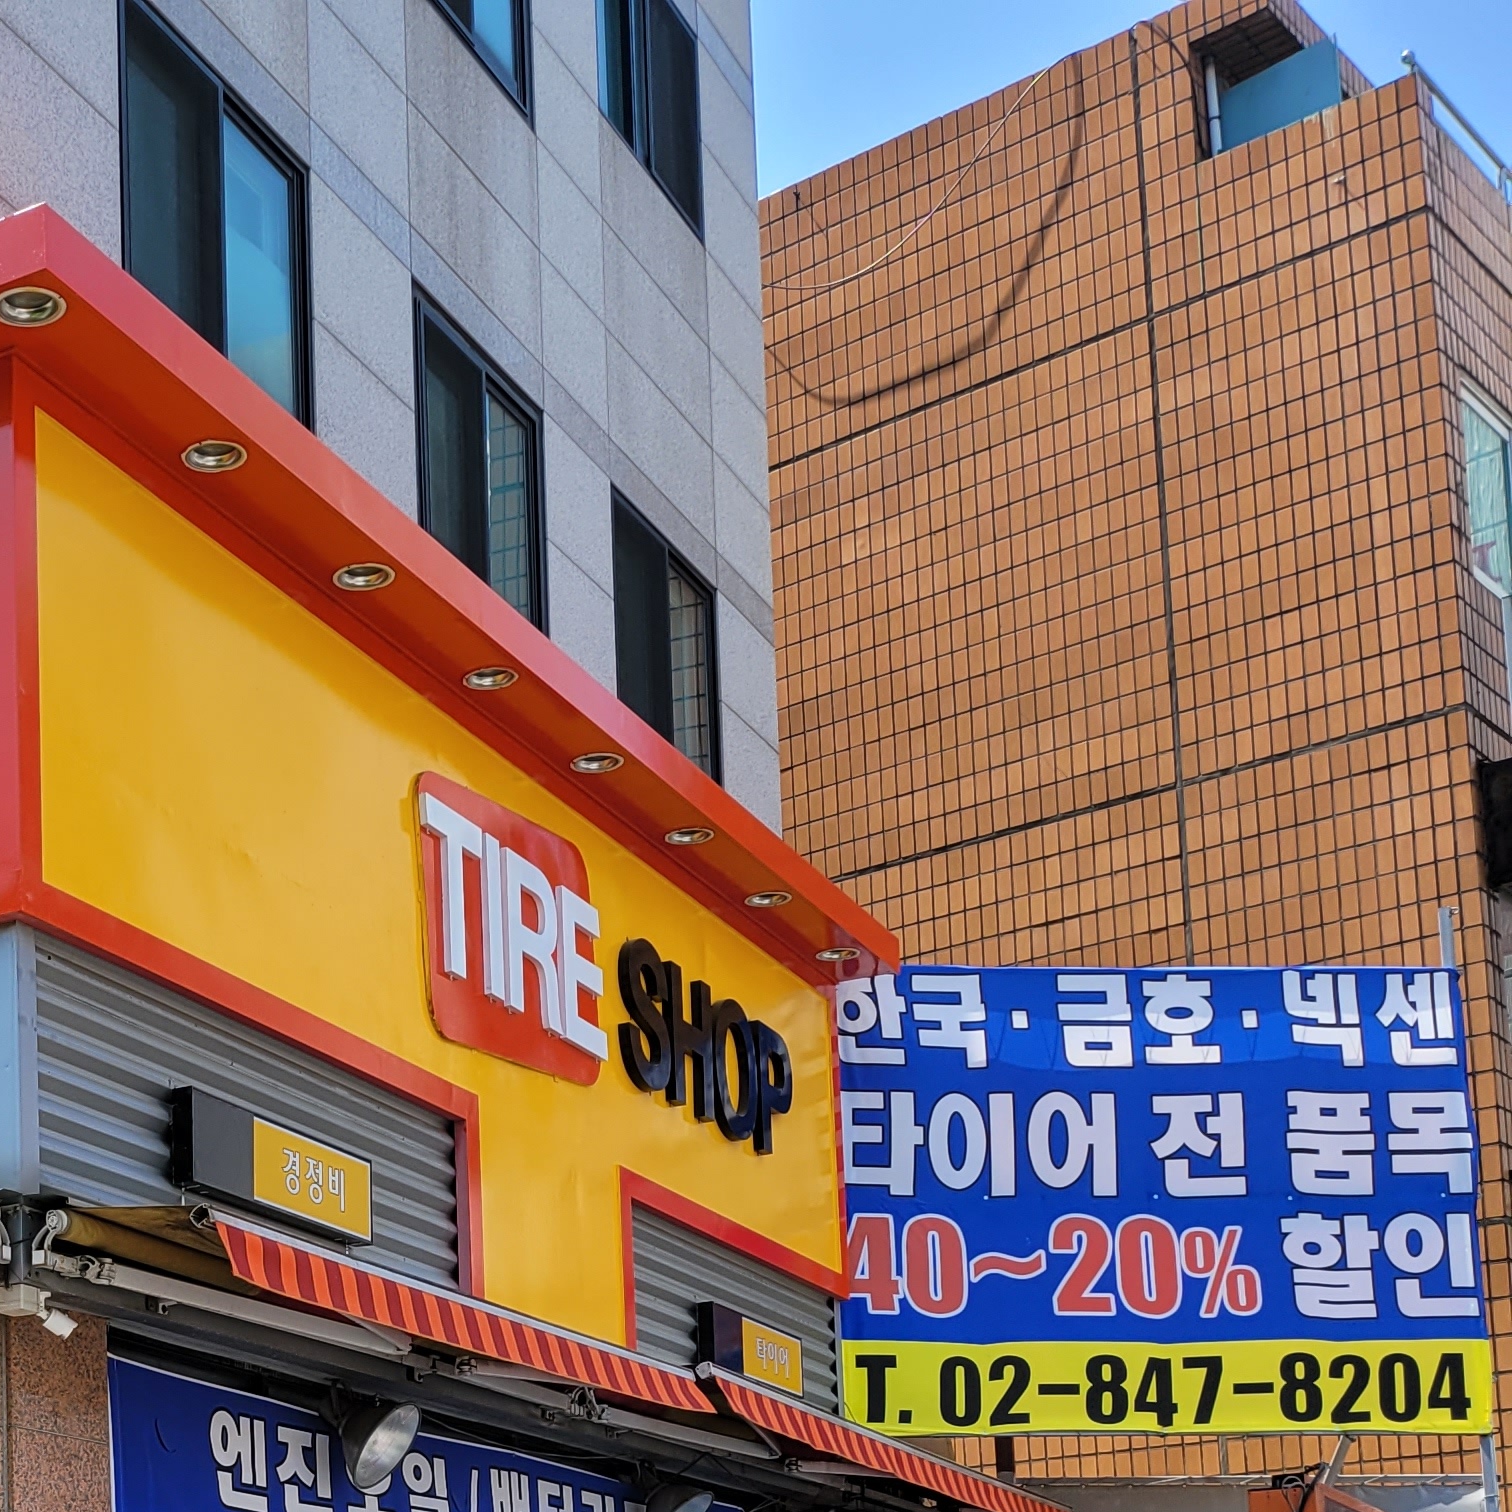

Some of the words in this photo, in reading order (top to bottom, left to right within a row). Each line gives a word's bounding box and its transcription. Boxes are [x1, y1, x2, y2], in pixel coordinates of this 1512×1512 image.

[419, 792, 608, 1062] TIRE
[617, 937, 793, 1156] SHOP
[281, 1147, 346, 1213] 경정비
[841, 1089, 1118, 1199] 타이어
[1150, 1091, 1247, 1199] 전
[1286, 1089, 1475, 1196] 품목
[847, 1213, 1262, 1320] 40~20%
[1280, 1211, 1480, 1320] 할인
[755, 1336, 790, 1380] 타이어
[855, 1353, 913, 1426] T.
[939, 1351, 1472, 1430] 02-847-8204
